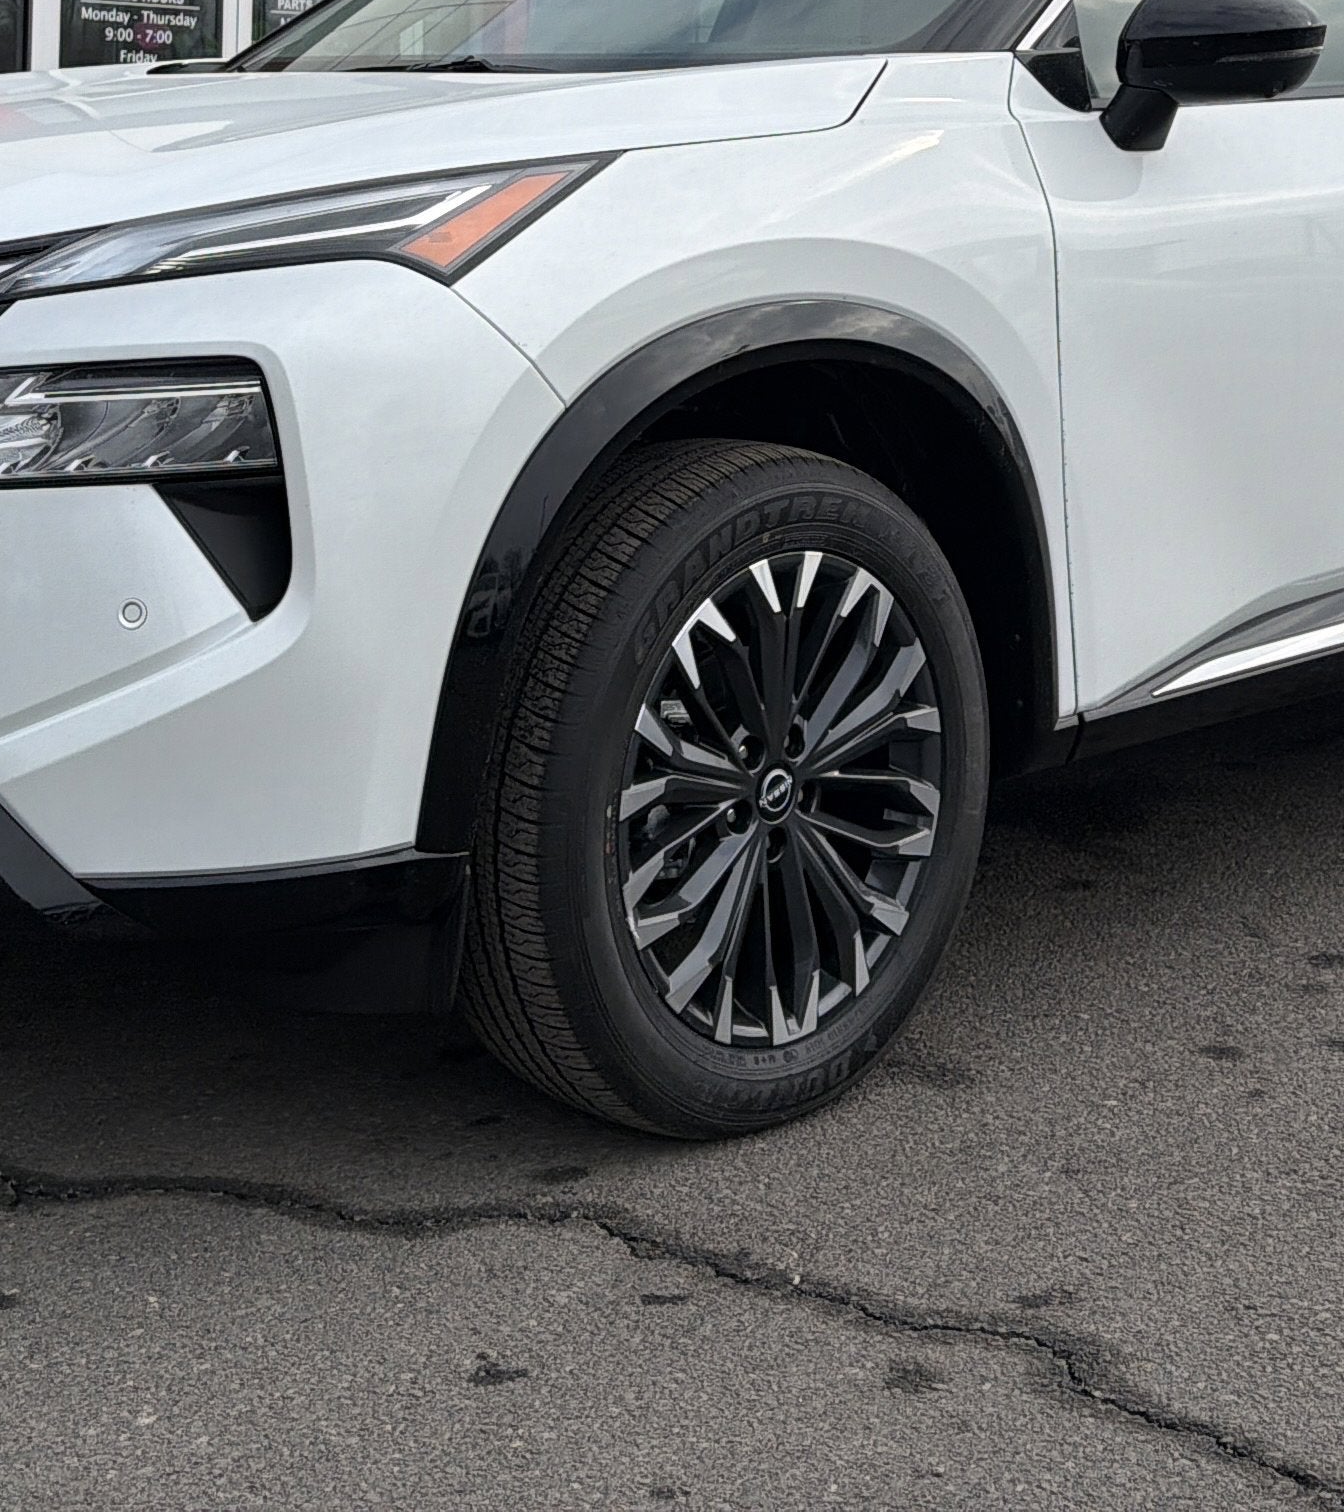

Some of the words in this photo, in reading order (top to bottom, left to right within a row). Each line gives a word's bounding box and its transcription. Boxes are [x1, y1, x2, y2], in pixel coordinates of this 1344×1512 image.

[81, 6, 130, 26] Monday
[141, 11, 197, 29] Thursday
[105, 27, 133, 42] 9:00
[145, 29, 173, 45] 7:00
[119, 49, 158, 64] Friday
